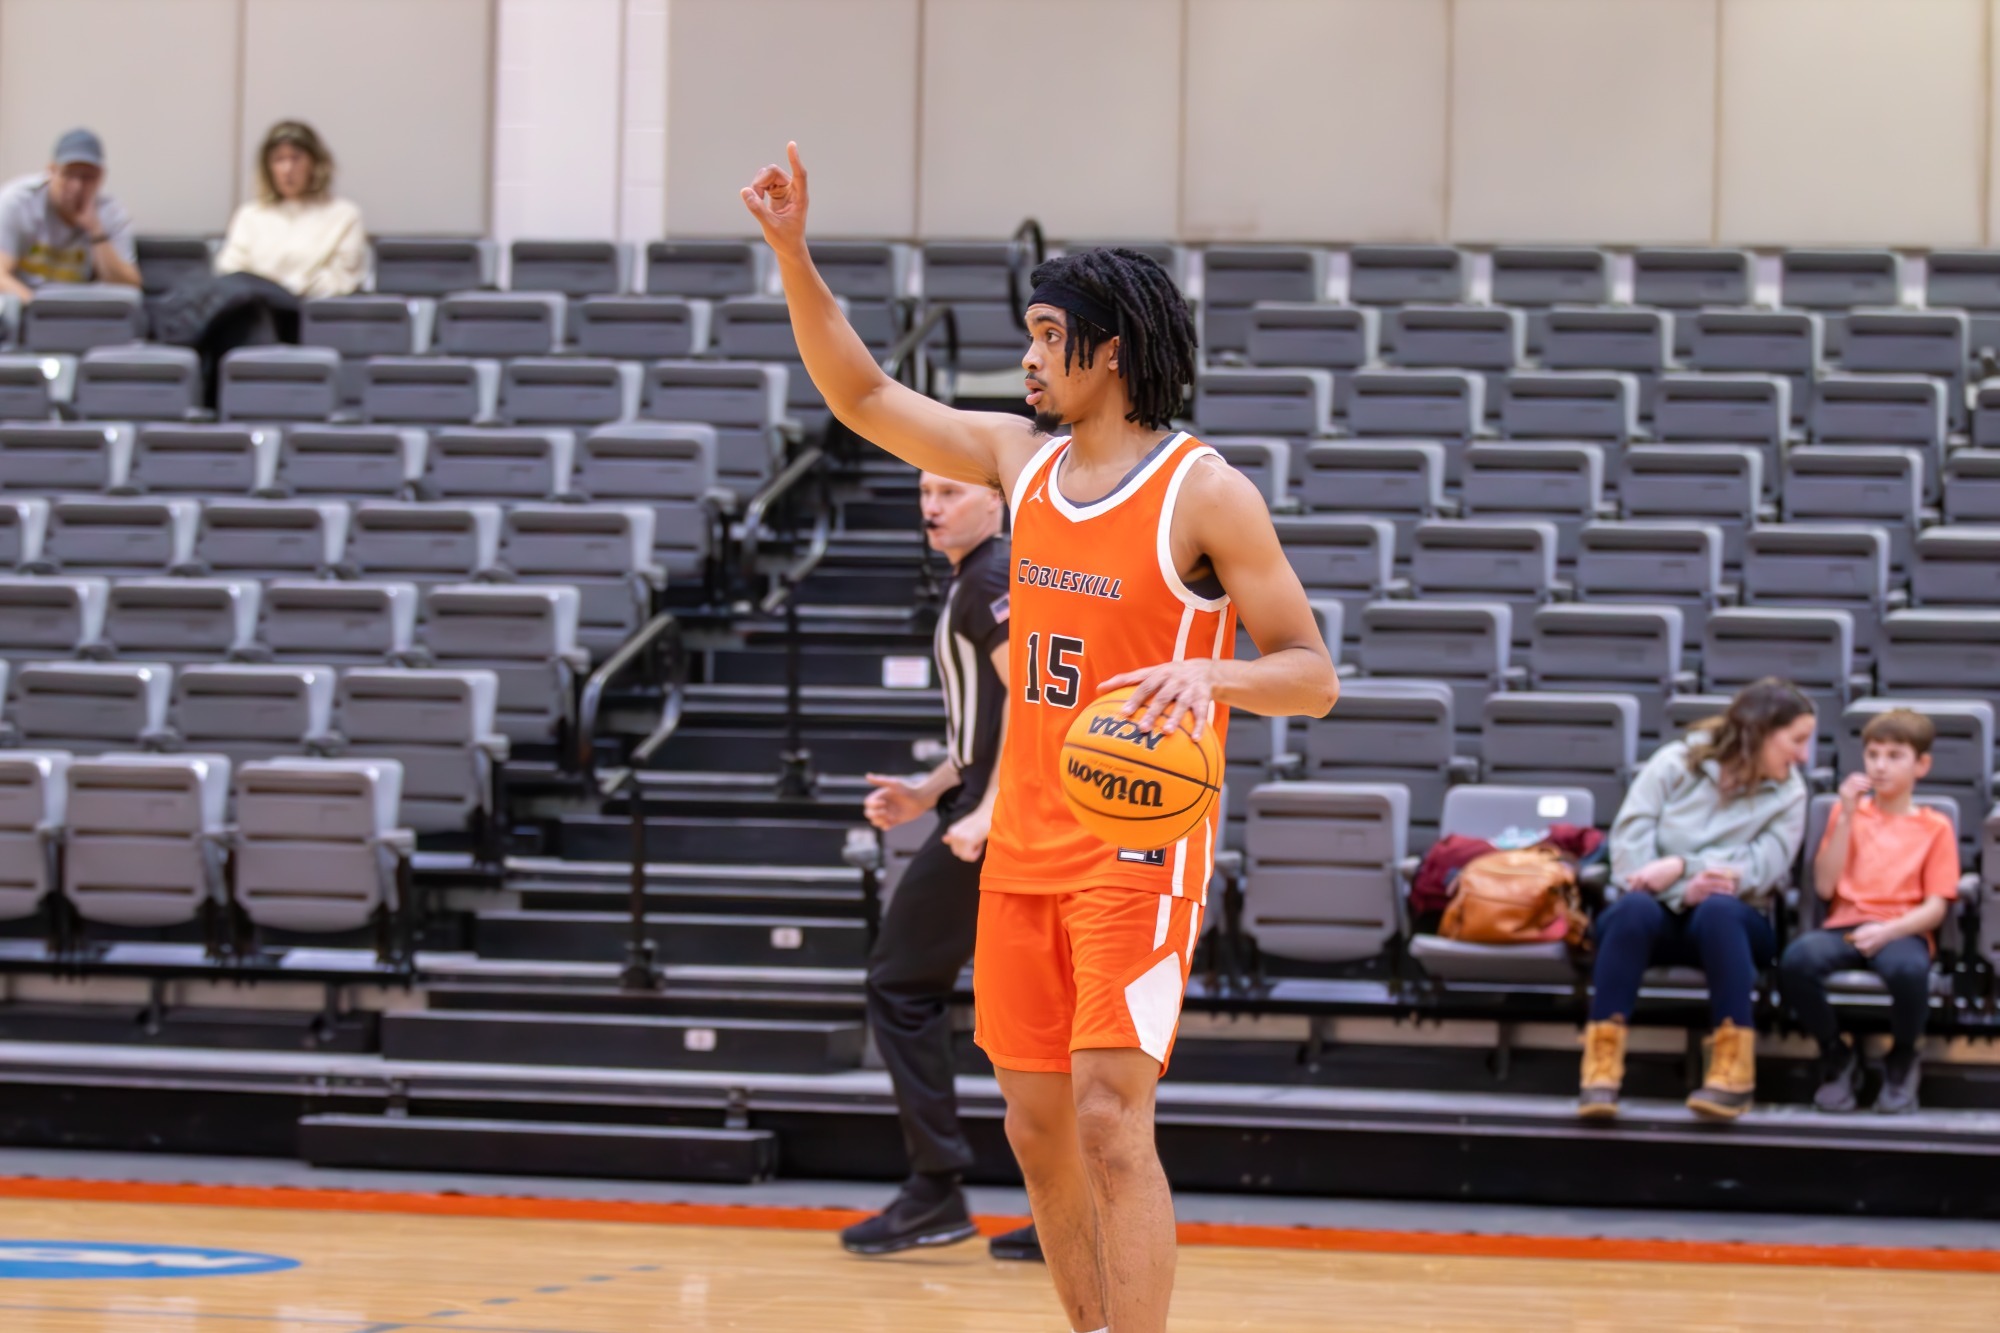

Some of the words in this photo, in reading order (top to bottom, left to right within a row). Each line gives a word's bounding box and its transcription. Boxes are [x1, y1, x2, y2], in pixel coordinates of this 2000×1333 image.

[1018, 558, 1122, 600] COBLESKILL
[1025, 632, 1085, 710] 15
[1088, 715, 1166, 751] NCAA
[1067, 755, 1163, 807] Wilson
[1151, 849, 1158, 859] L
